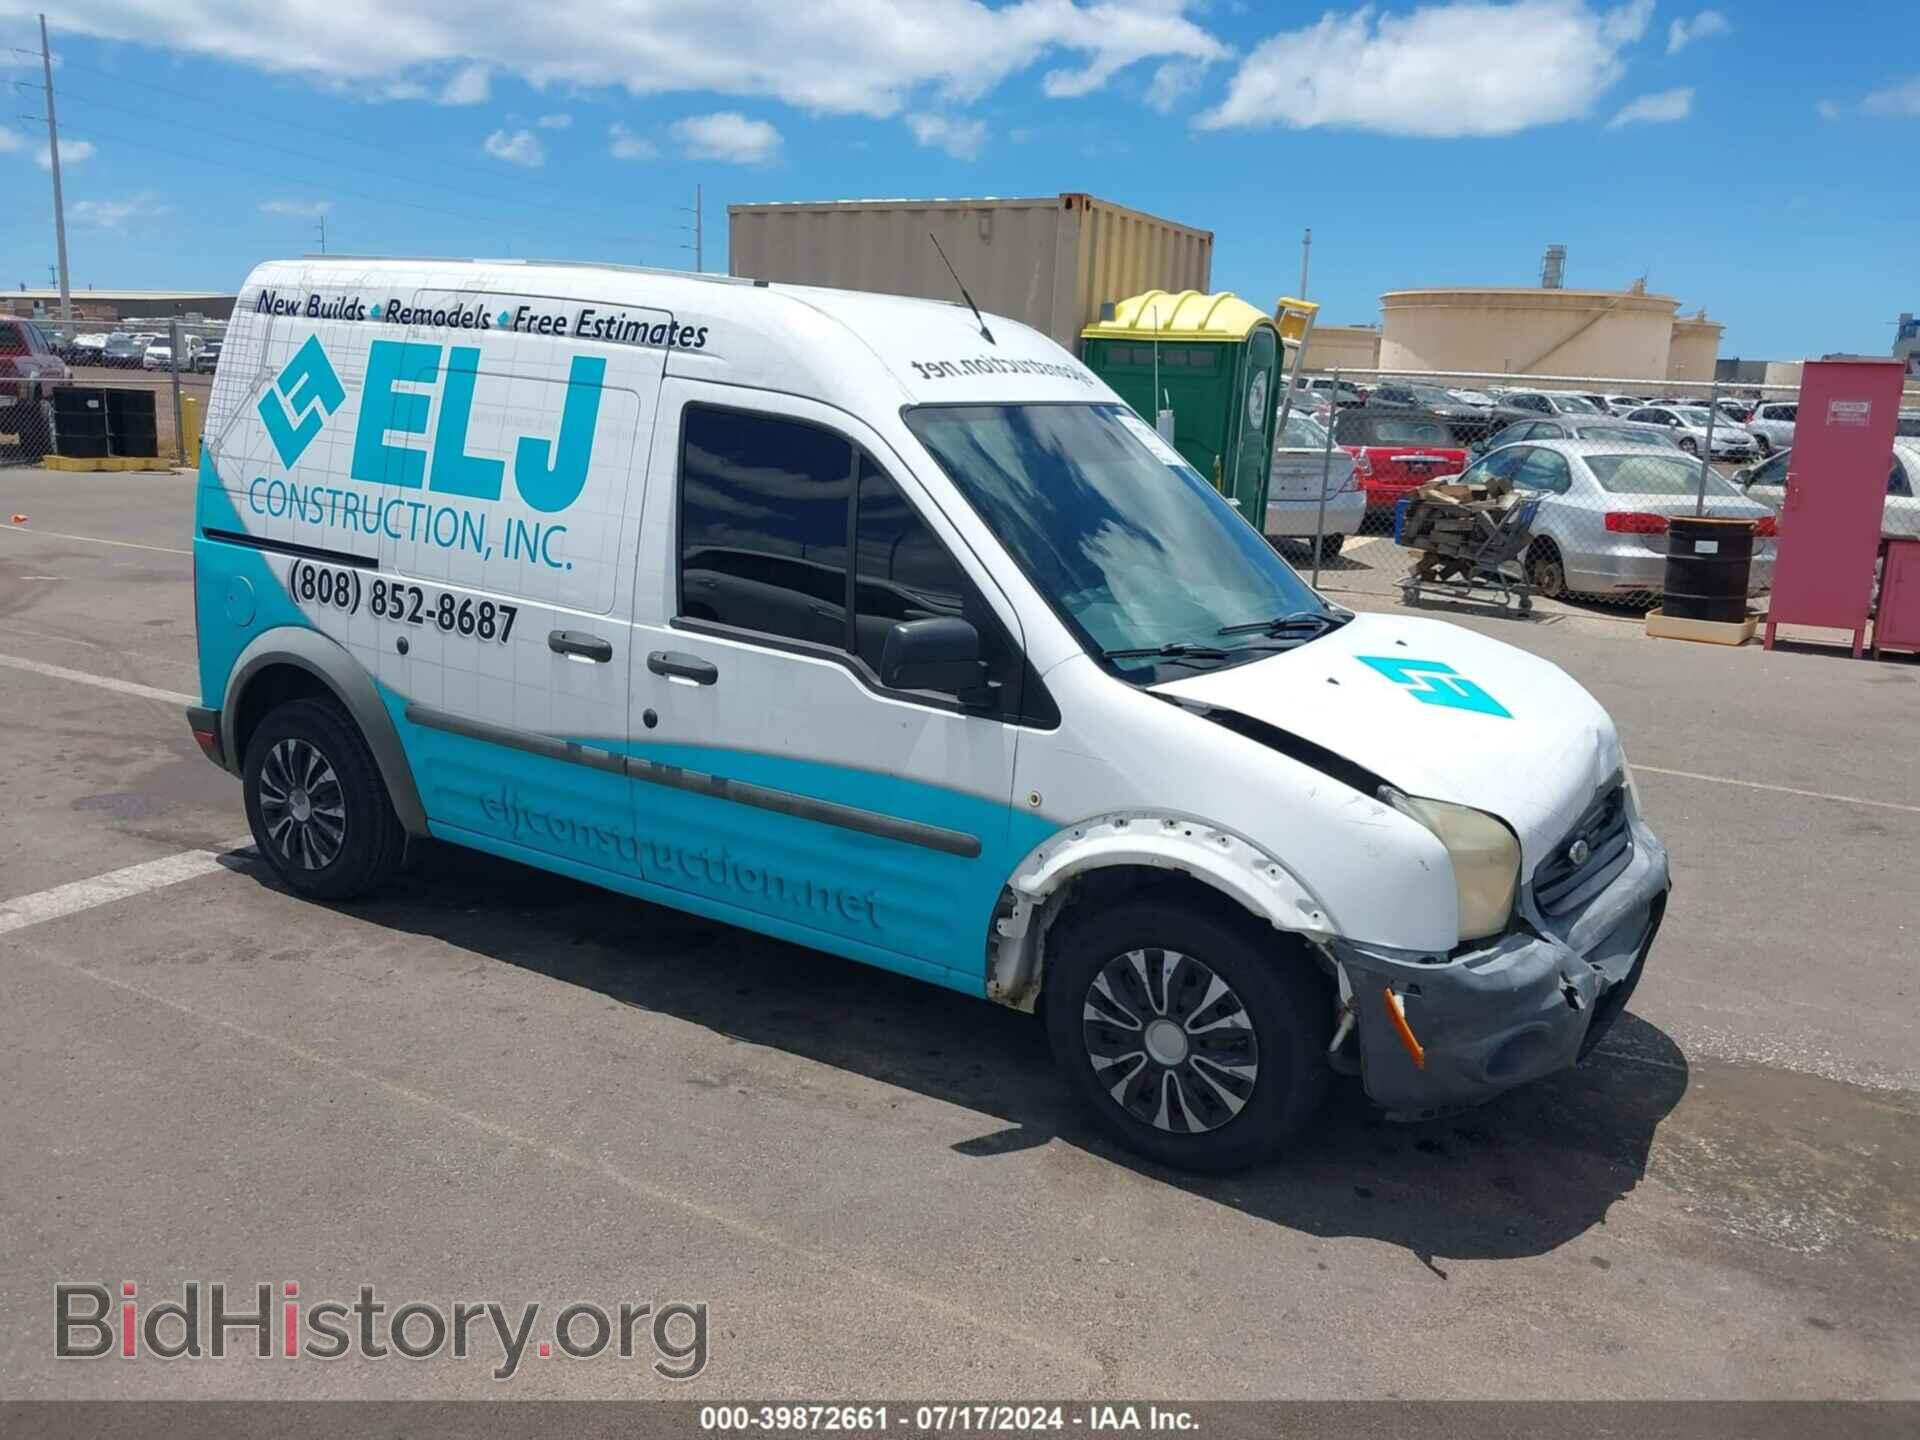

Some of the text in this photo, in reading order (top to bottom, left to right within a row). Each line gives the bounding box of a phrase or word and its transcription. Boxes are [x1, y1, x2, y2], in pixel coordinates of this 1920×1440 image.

[256, 289, 710, 349] New Builds Remodels Free Estimates
[350, 338, 608, 513] ELJ
[248, 476, 573, 570] CONSTRUCTION, INC.
[289, 559, 519, 645] (808) 852-8687
[480, 783, 885, 930] eljconstruction.net
